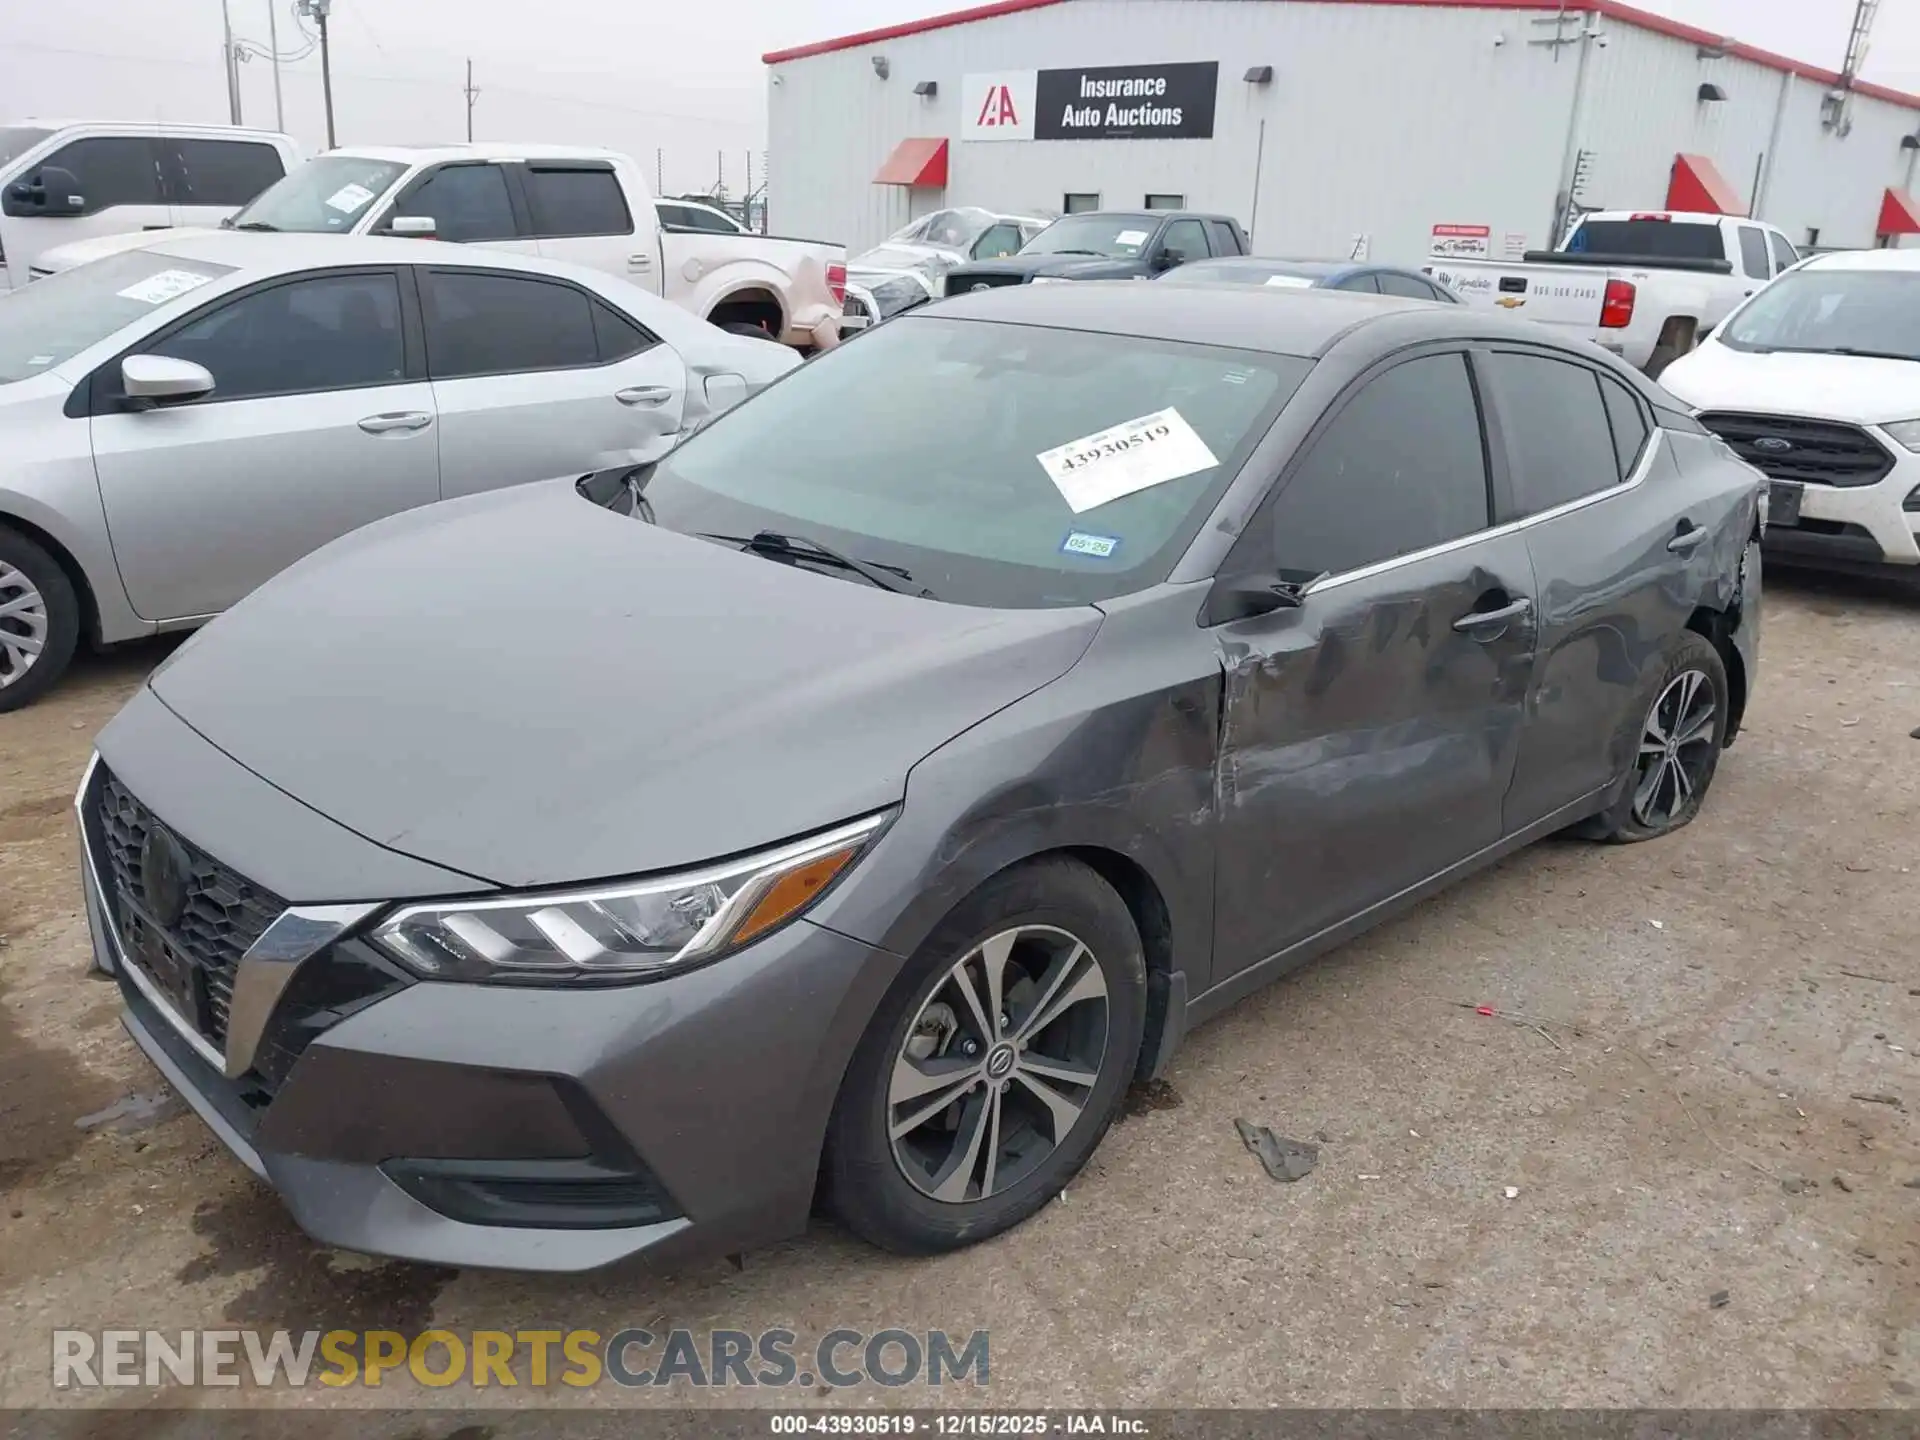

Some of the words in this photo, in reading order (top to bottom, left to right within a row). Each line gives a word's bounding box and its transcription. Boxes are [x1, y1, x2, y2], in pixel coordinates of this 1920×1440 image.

[1080, 74, 1167, 98] Insurance
[1061, 104, 1100, 128] Auto
[1104, 102, 1183, 127] Auctions
[1062, 425, 1170, 471] 43930519
